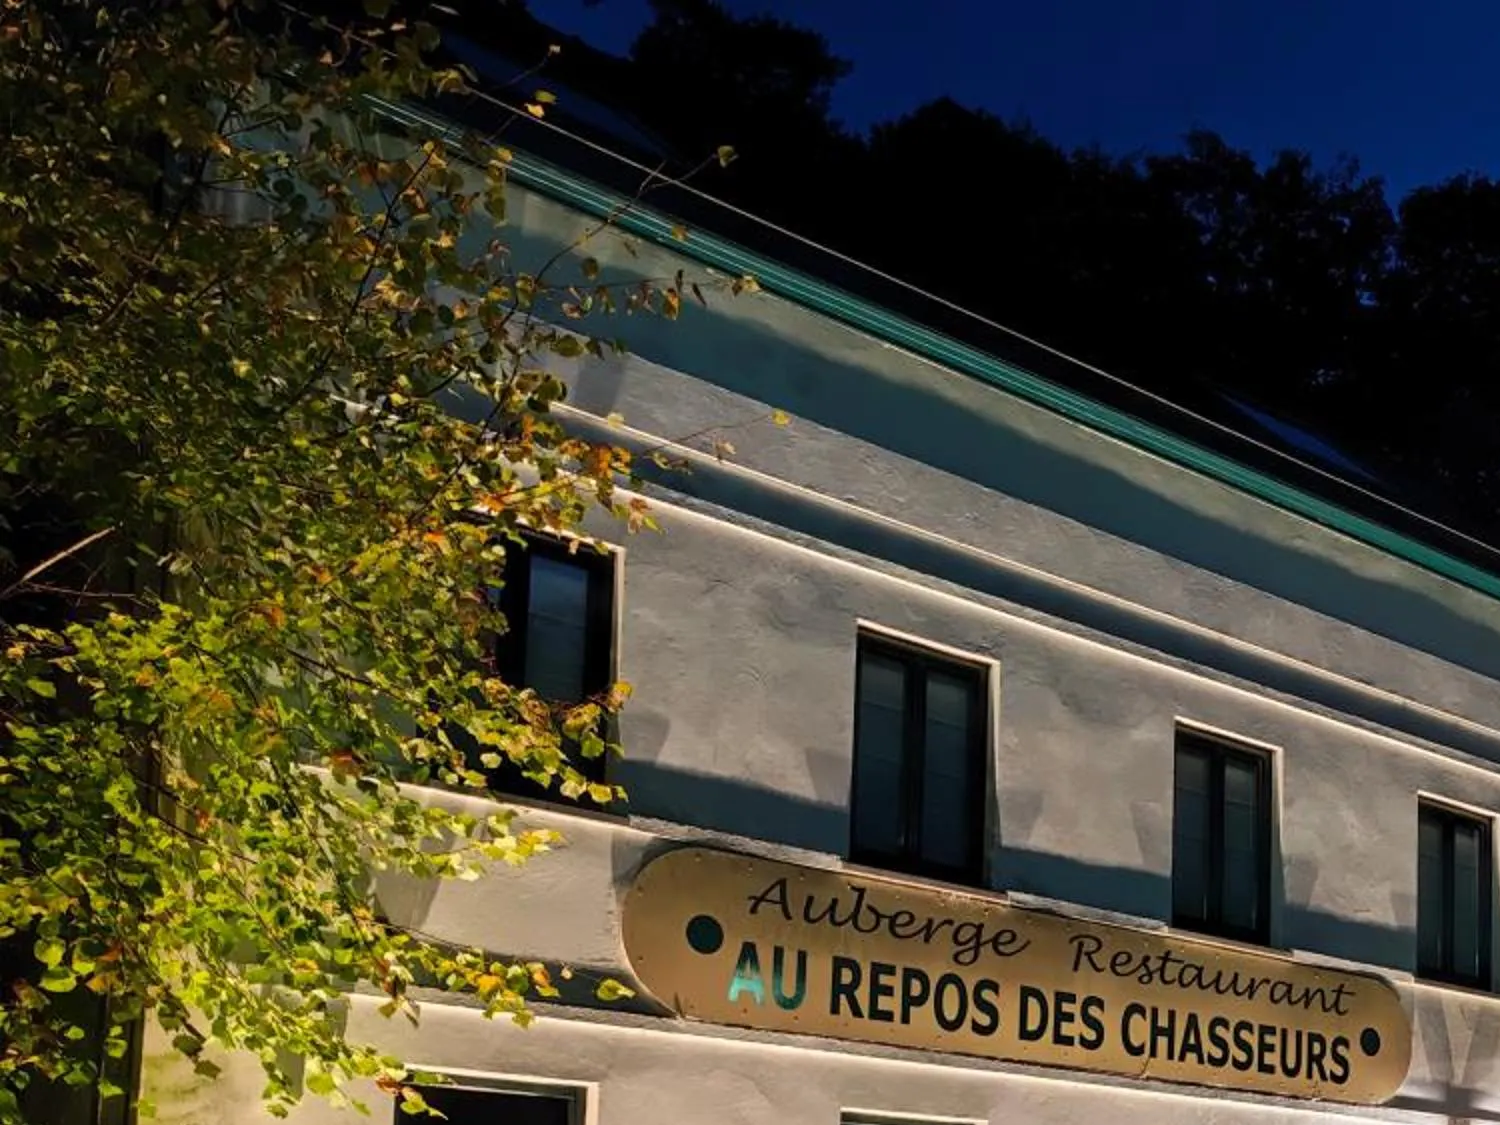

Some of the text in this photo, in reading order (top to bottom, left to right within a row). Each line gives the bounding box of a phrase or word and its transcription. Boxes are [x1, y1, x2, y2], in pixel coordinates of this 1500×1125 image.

[727, 941, 1351, 1085] AU REPOS DES CHASSEURS
[748, 878, 1357, 1016] Auberge Restaurant
